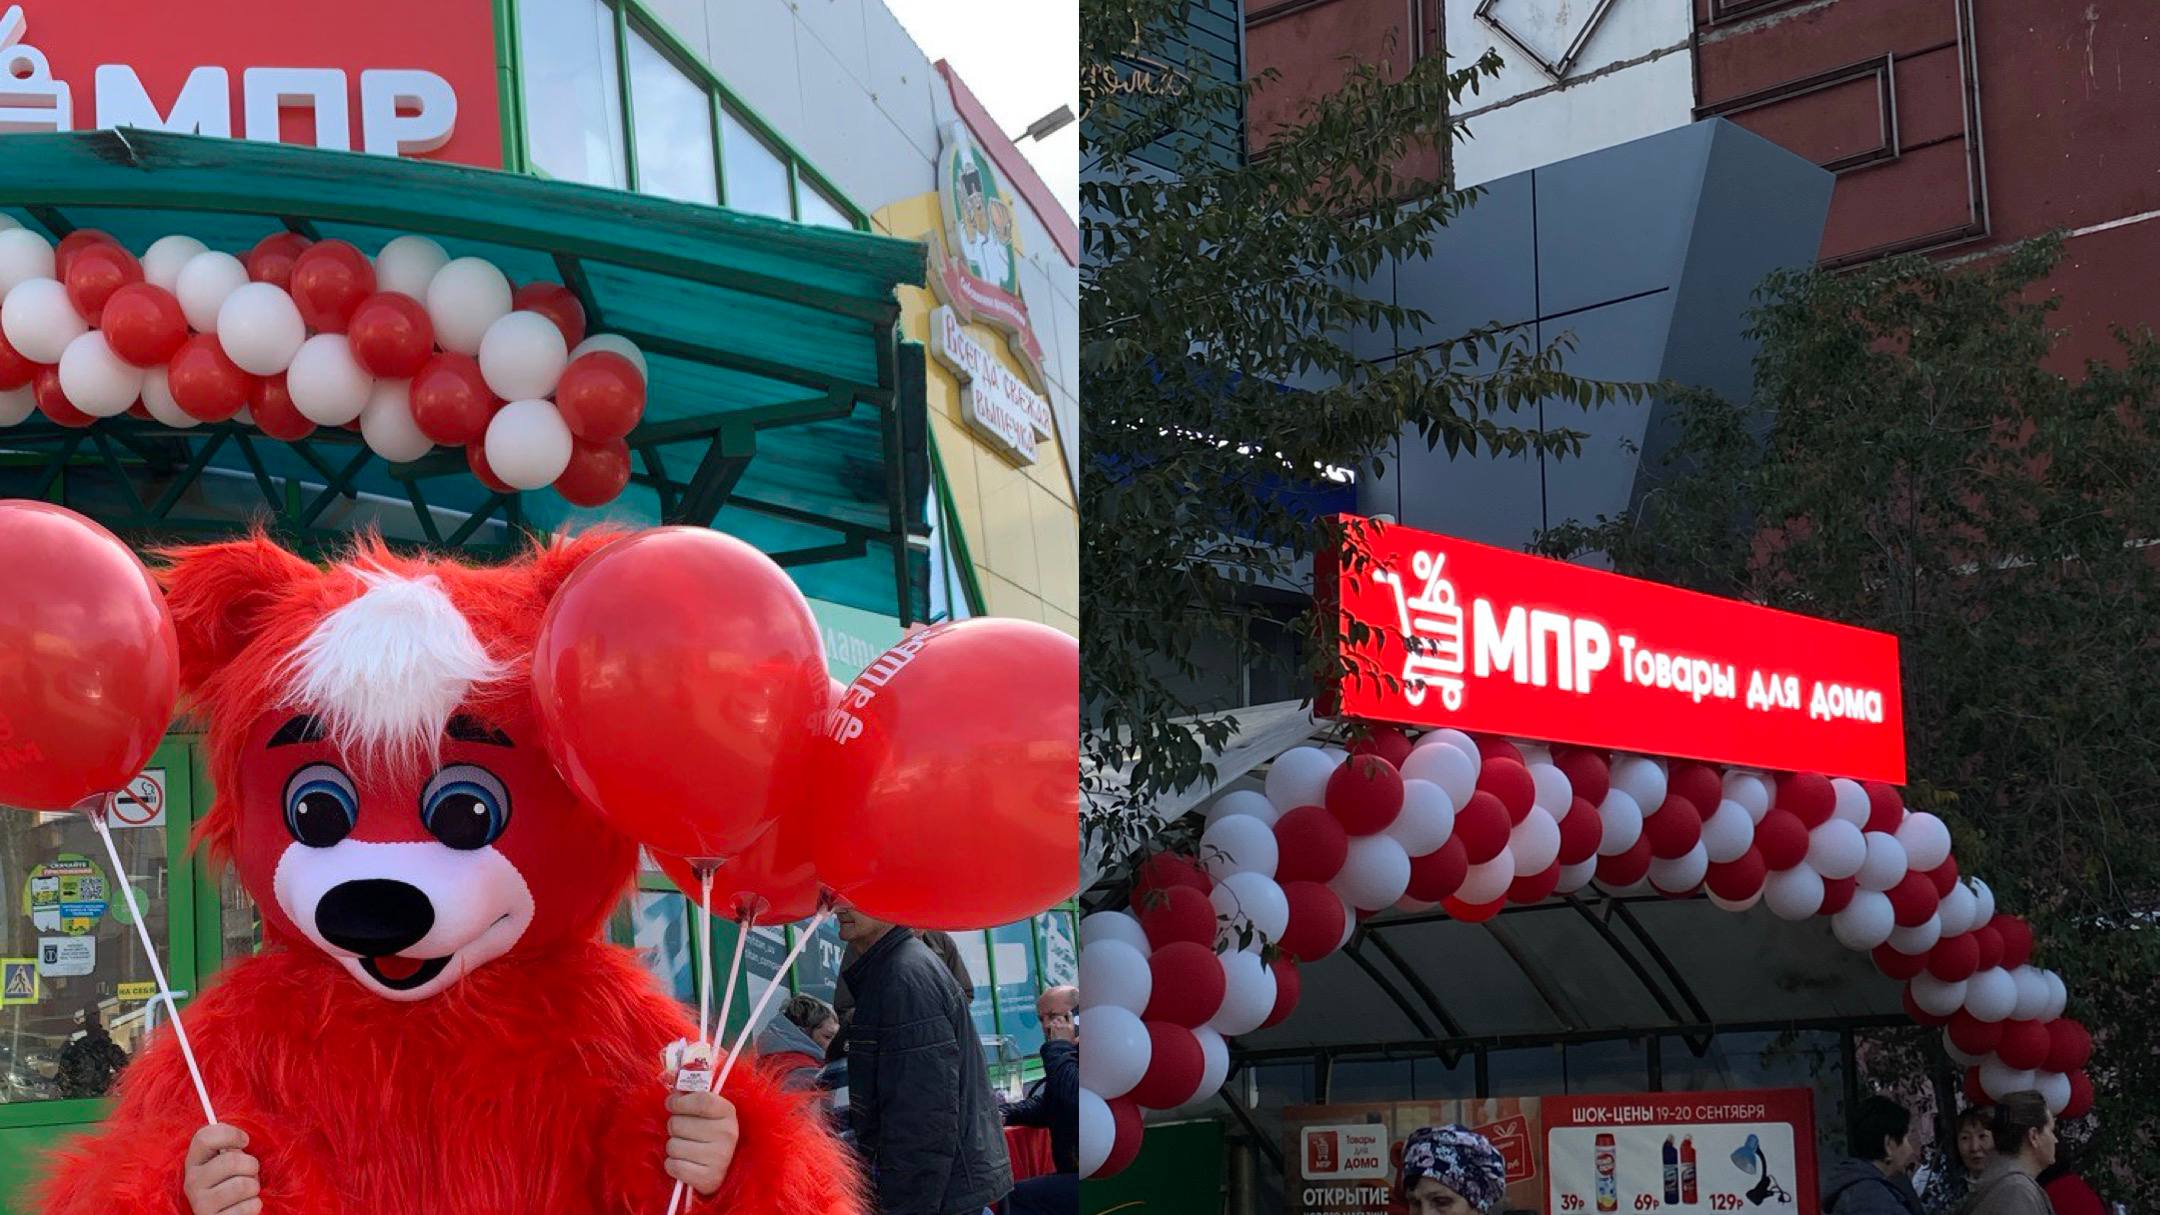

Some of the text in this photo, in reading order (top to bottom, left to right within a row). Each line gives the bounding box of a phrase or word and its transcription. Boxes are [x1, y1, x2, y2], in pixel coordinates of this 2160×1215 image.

[94, 64, 458, 157] МПР
[1472, 599, 1884, 724] МПР Товары для дома
[1572, 1104, 1766, 1123] ШОК-ЦЕНЫ 19-20 СЕНТЯБРЯ
[1344, 1158, 1379, 1171] дома
[1303, 1187, 1390, 1206] ОТКРЫТИЕ
